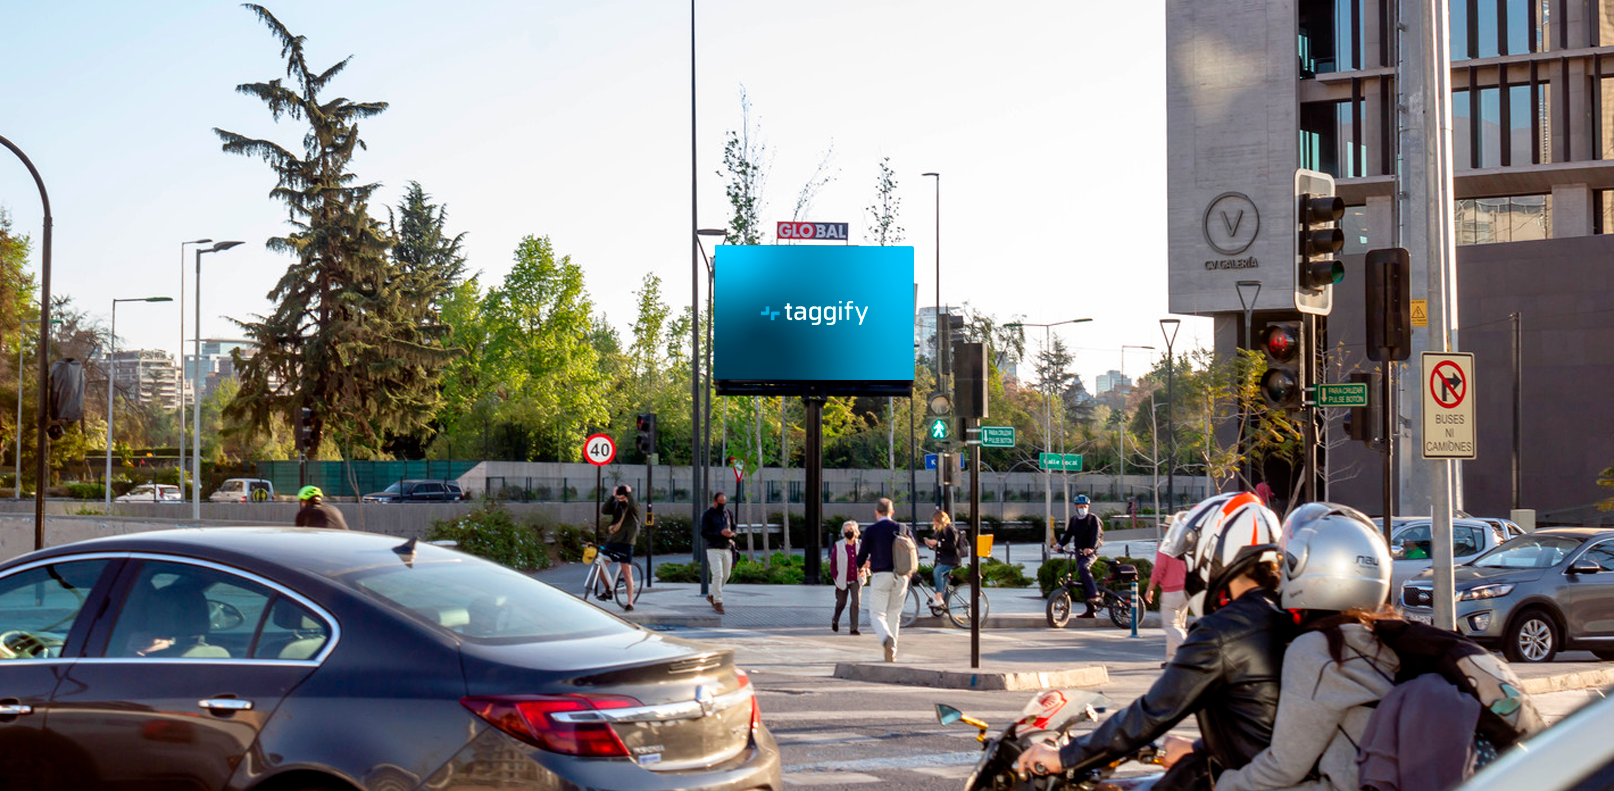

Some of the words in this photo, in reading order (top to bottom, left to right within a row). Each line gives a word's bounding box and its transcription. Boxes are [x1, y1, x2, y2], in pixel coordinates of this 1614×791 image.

[778, 223, 847, 238] GLOBAL
[1205, 260, 1218, 270] CV
[784, 301, 868, 325] taggify
[1435, 414, 1465, 424] BUSES
[1445, 428, 1455, 438] NI
[590, 443, 610, 457] 40
